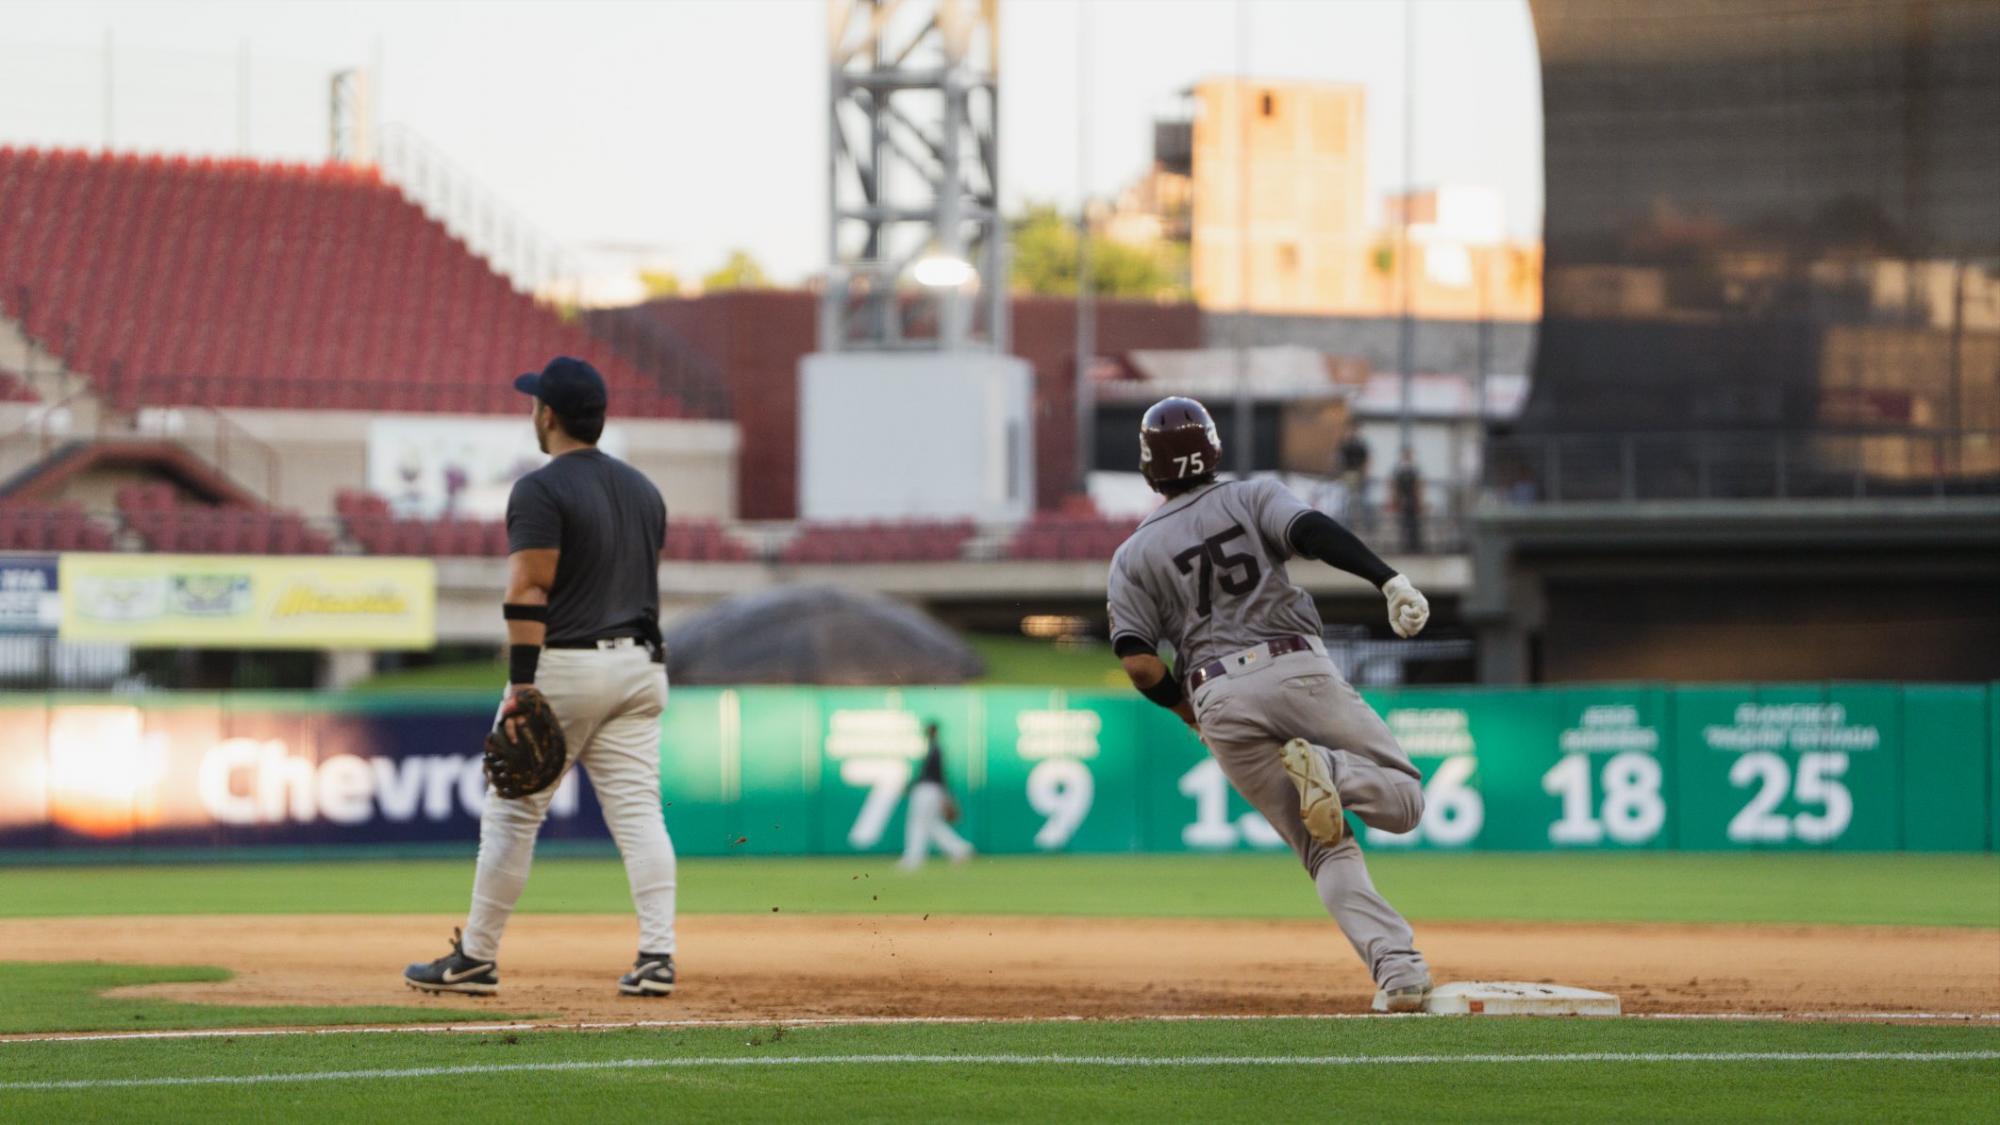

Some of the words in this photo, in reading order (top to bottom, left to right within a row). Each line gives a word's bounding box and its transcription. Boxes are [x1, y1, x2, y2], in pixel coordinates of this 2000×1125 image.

[1173, 452, 1204, 478] 75
[1172, 525, 1261, 618] 75
[840, 758, 911, 848] 7
[1026, 758, 1094, 849] 9
[1366, 755, 1485, 845] 6
[1542, 752, 1666, 845] 18
[1727, 751, 1853, 845] 25
